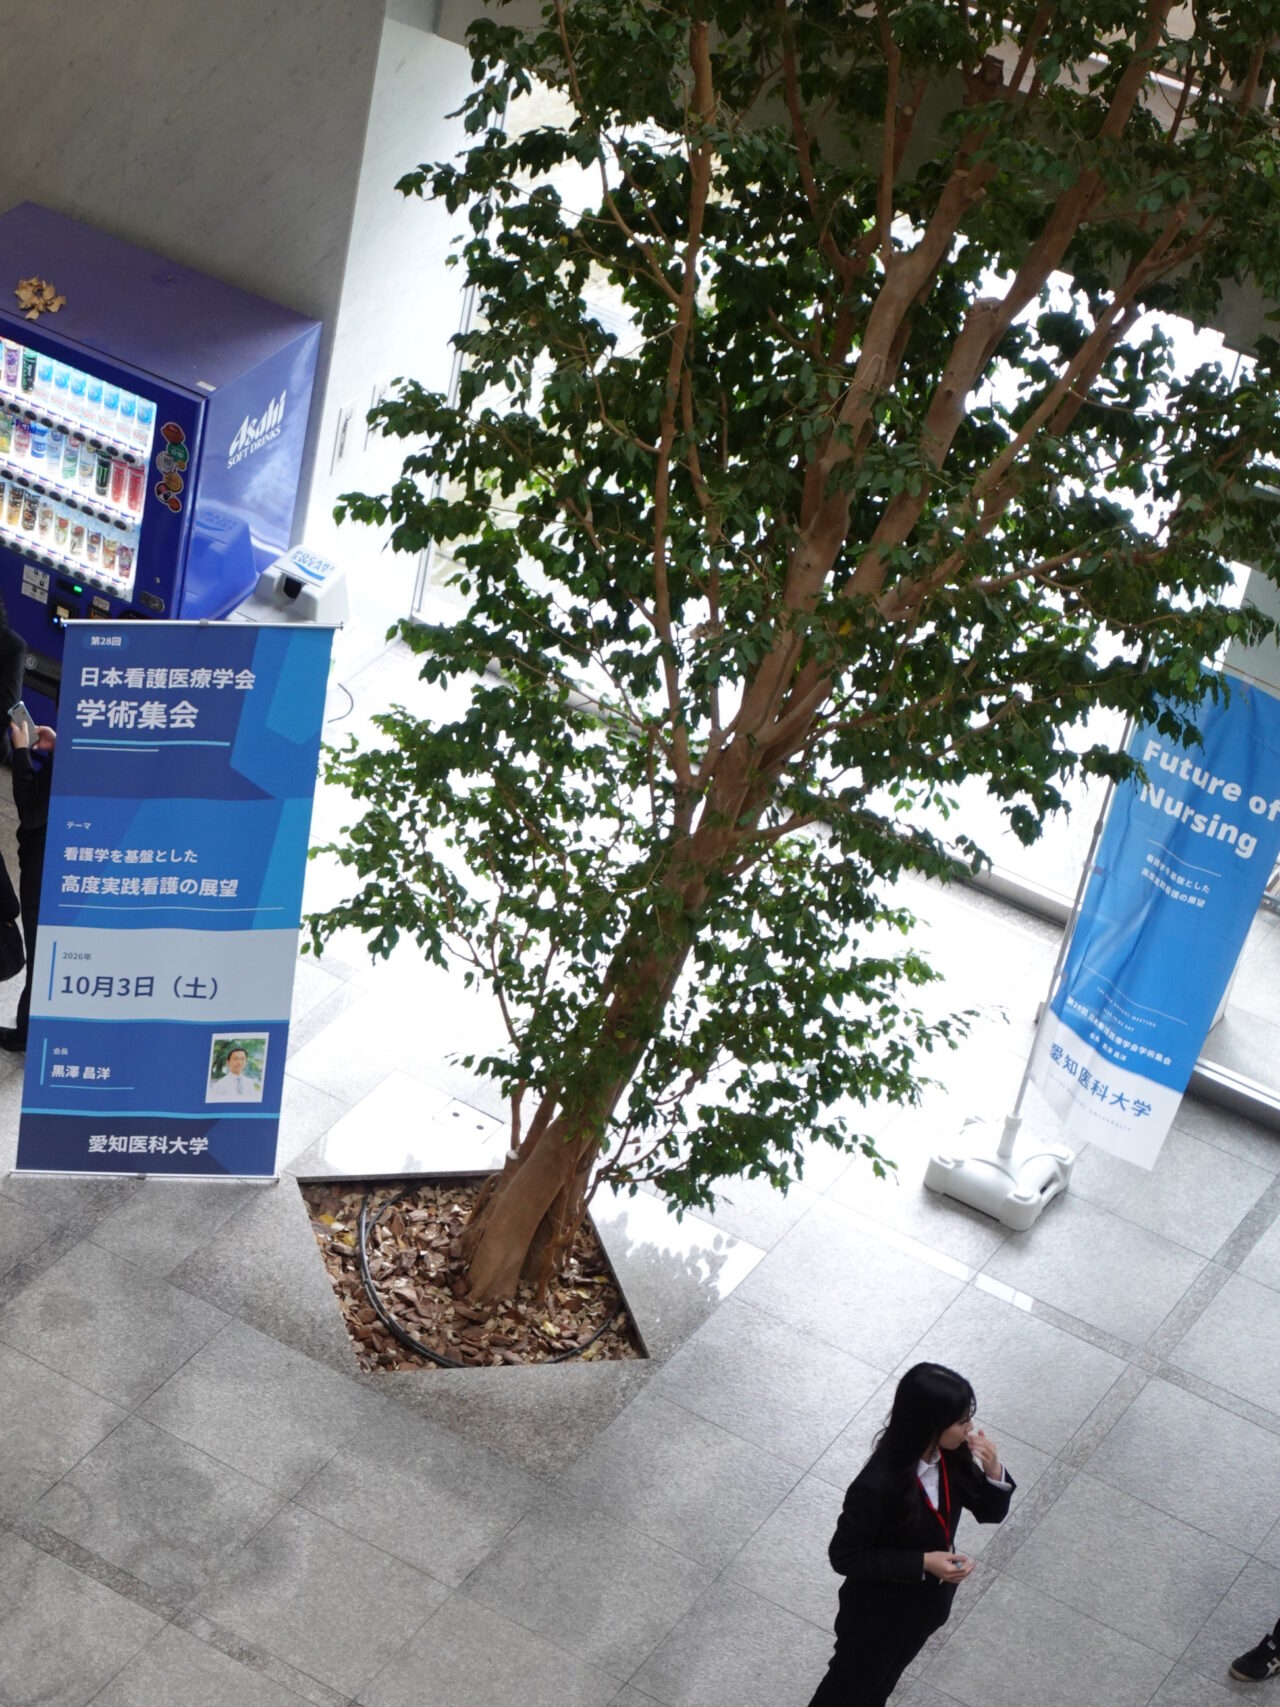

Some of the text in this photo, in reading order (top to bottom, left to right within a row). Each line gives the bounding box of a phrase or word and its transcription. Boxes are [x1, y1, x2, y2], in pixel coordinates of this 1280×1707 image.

[228, 388, 287, 457] Asahi
[226, 425, 282, 470] SOFT DRINKS
[91, 635, 122, 647] 第28回
[80, 666, 257, 691] 日本看護医療学会
[75, 700, 200, 730] 学術集会
[1142, 738, 1280, 822] Future of
[65, 820, 92, 831] テーマ
[1139, 781, 1259, 860] Nursing
[63, 846, 199, 865] 看護学を基盤とした
[60, 874, 240, 898] 高度実践看護の展望
[62, 951, 93, 961] 2026年
[1049, 1042, 1152, 1118] 愛知医科大学
[87, 1134, 210, 1156] 愛知医科大学
